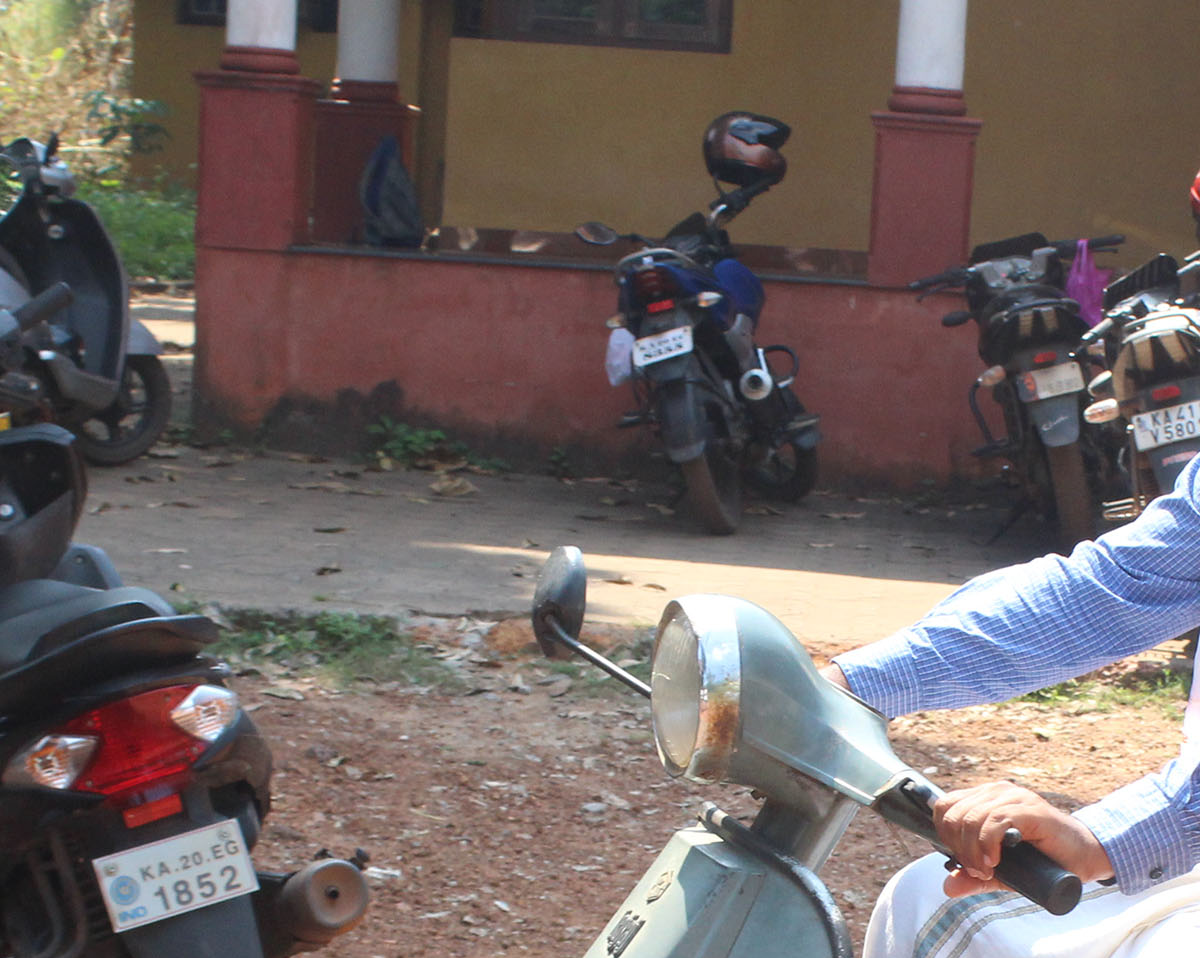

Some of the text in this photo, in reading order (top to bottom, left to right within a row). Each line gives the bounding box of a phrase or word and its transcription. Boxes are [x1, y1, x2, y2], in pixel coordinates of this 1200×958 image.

[1150, 405, 1195, 426] KA 41
[154, 864, 242, 911] 1852
